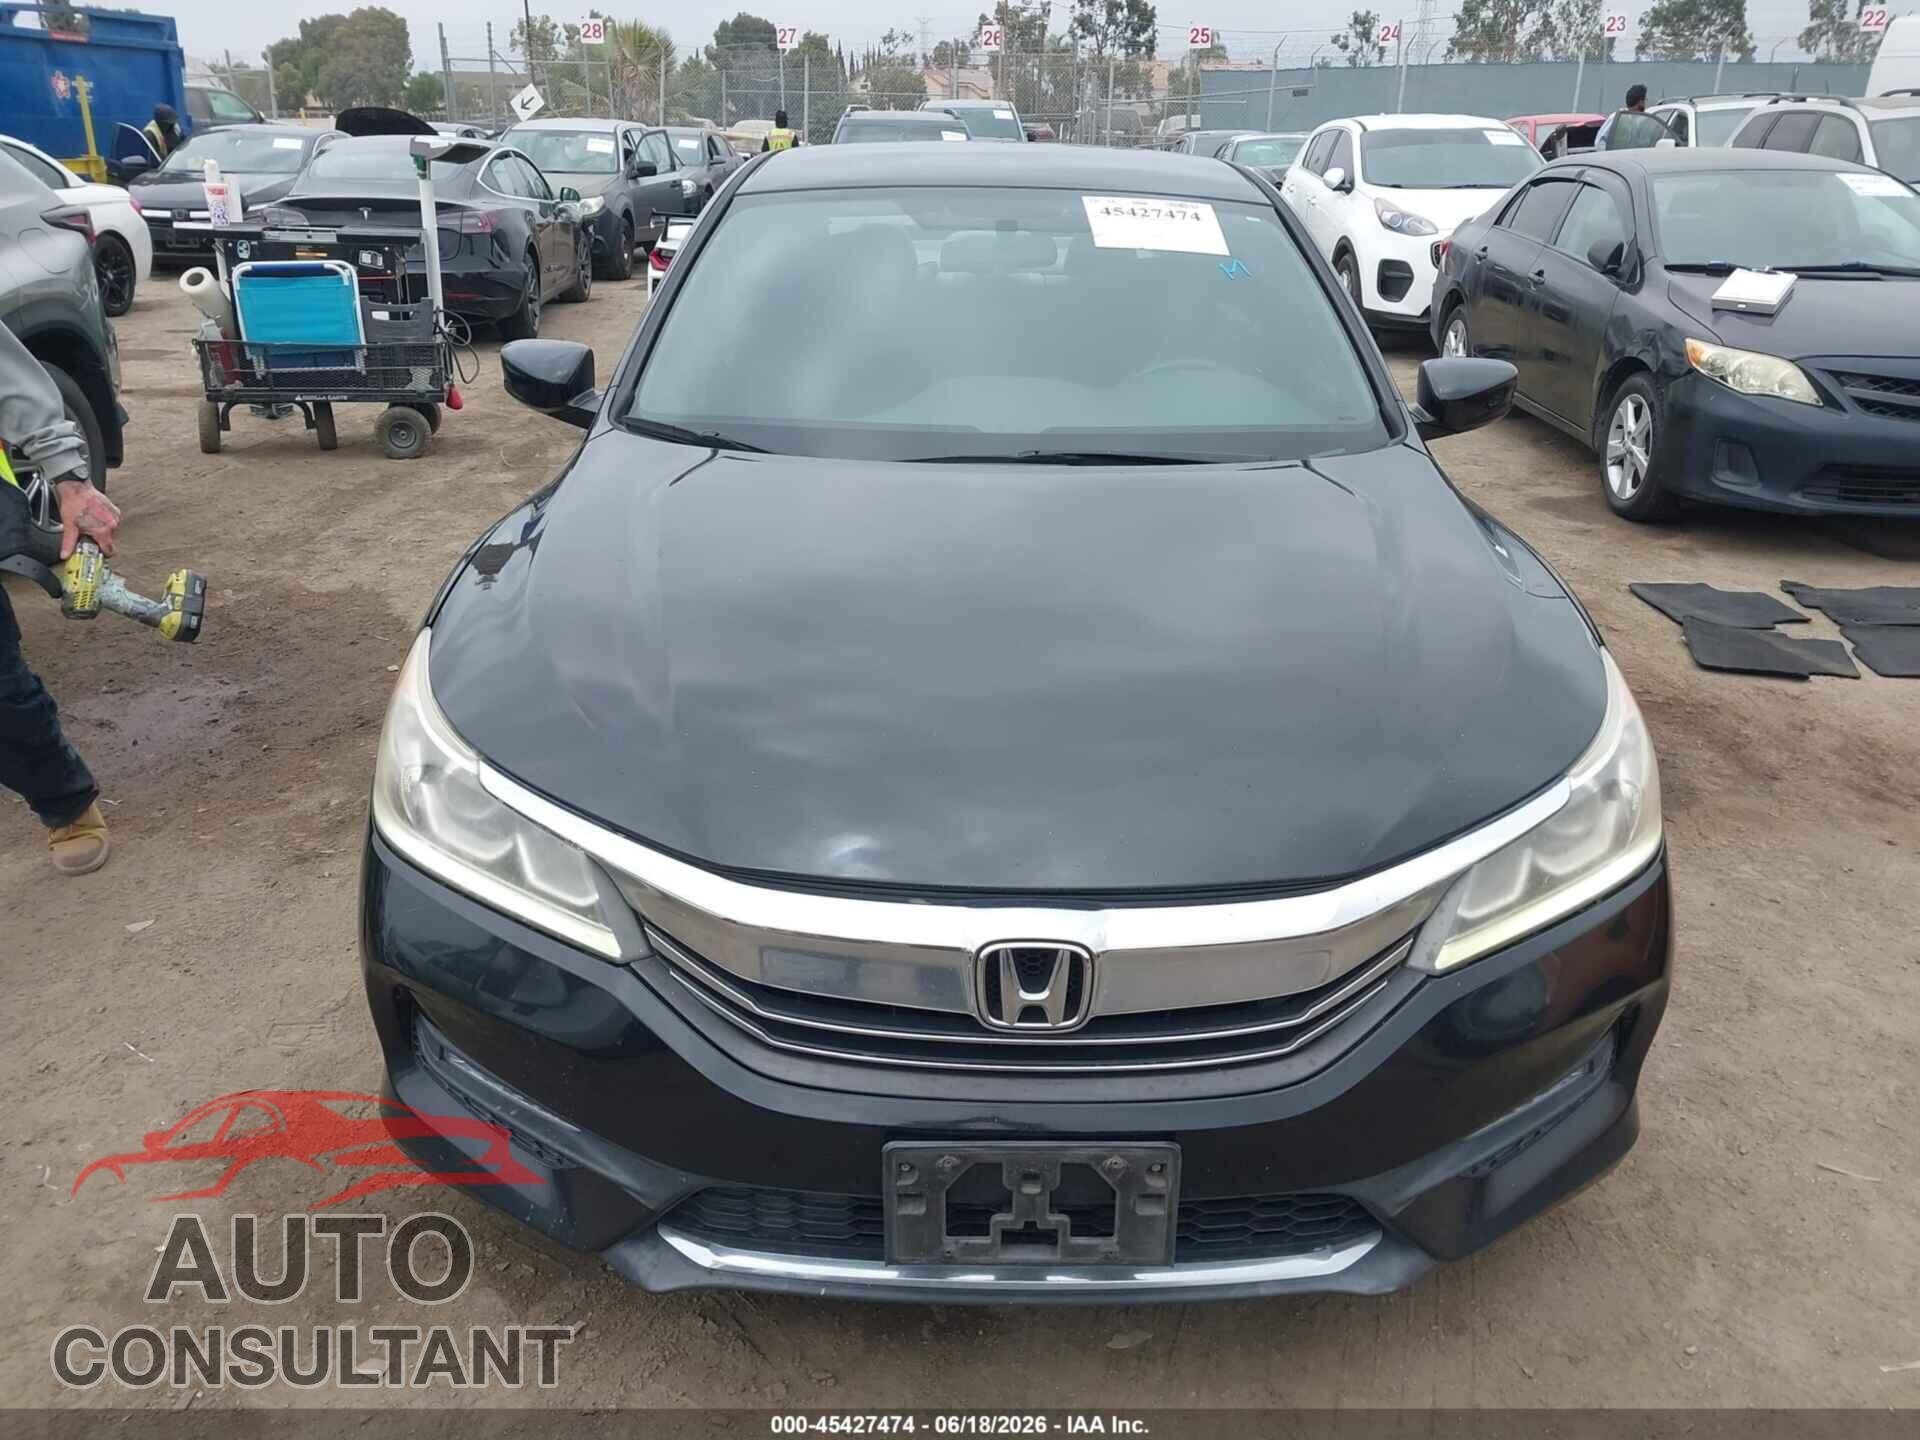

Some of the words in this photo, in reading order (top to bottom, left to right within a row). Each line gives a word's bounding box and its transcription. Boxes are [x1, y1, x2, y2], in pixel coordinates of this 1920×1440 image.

[1606, 15, 1626, 32] 23
[1862, 10, 1886, 27] 22
[581, 23, 602, 39] 28
[778, 28, 797, 44] 27
[1189, 27, 1210, 44] 25
[1380, 25, 1400, 42] 24
[1100, 206, 1201, 222] 45427474
